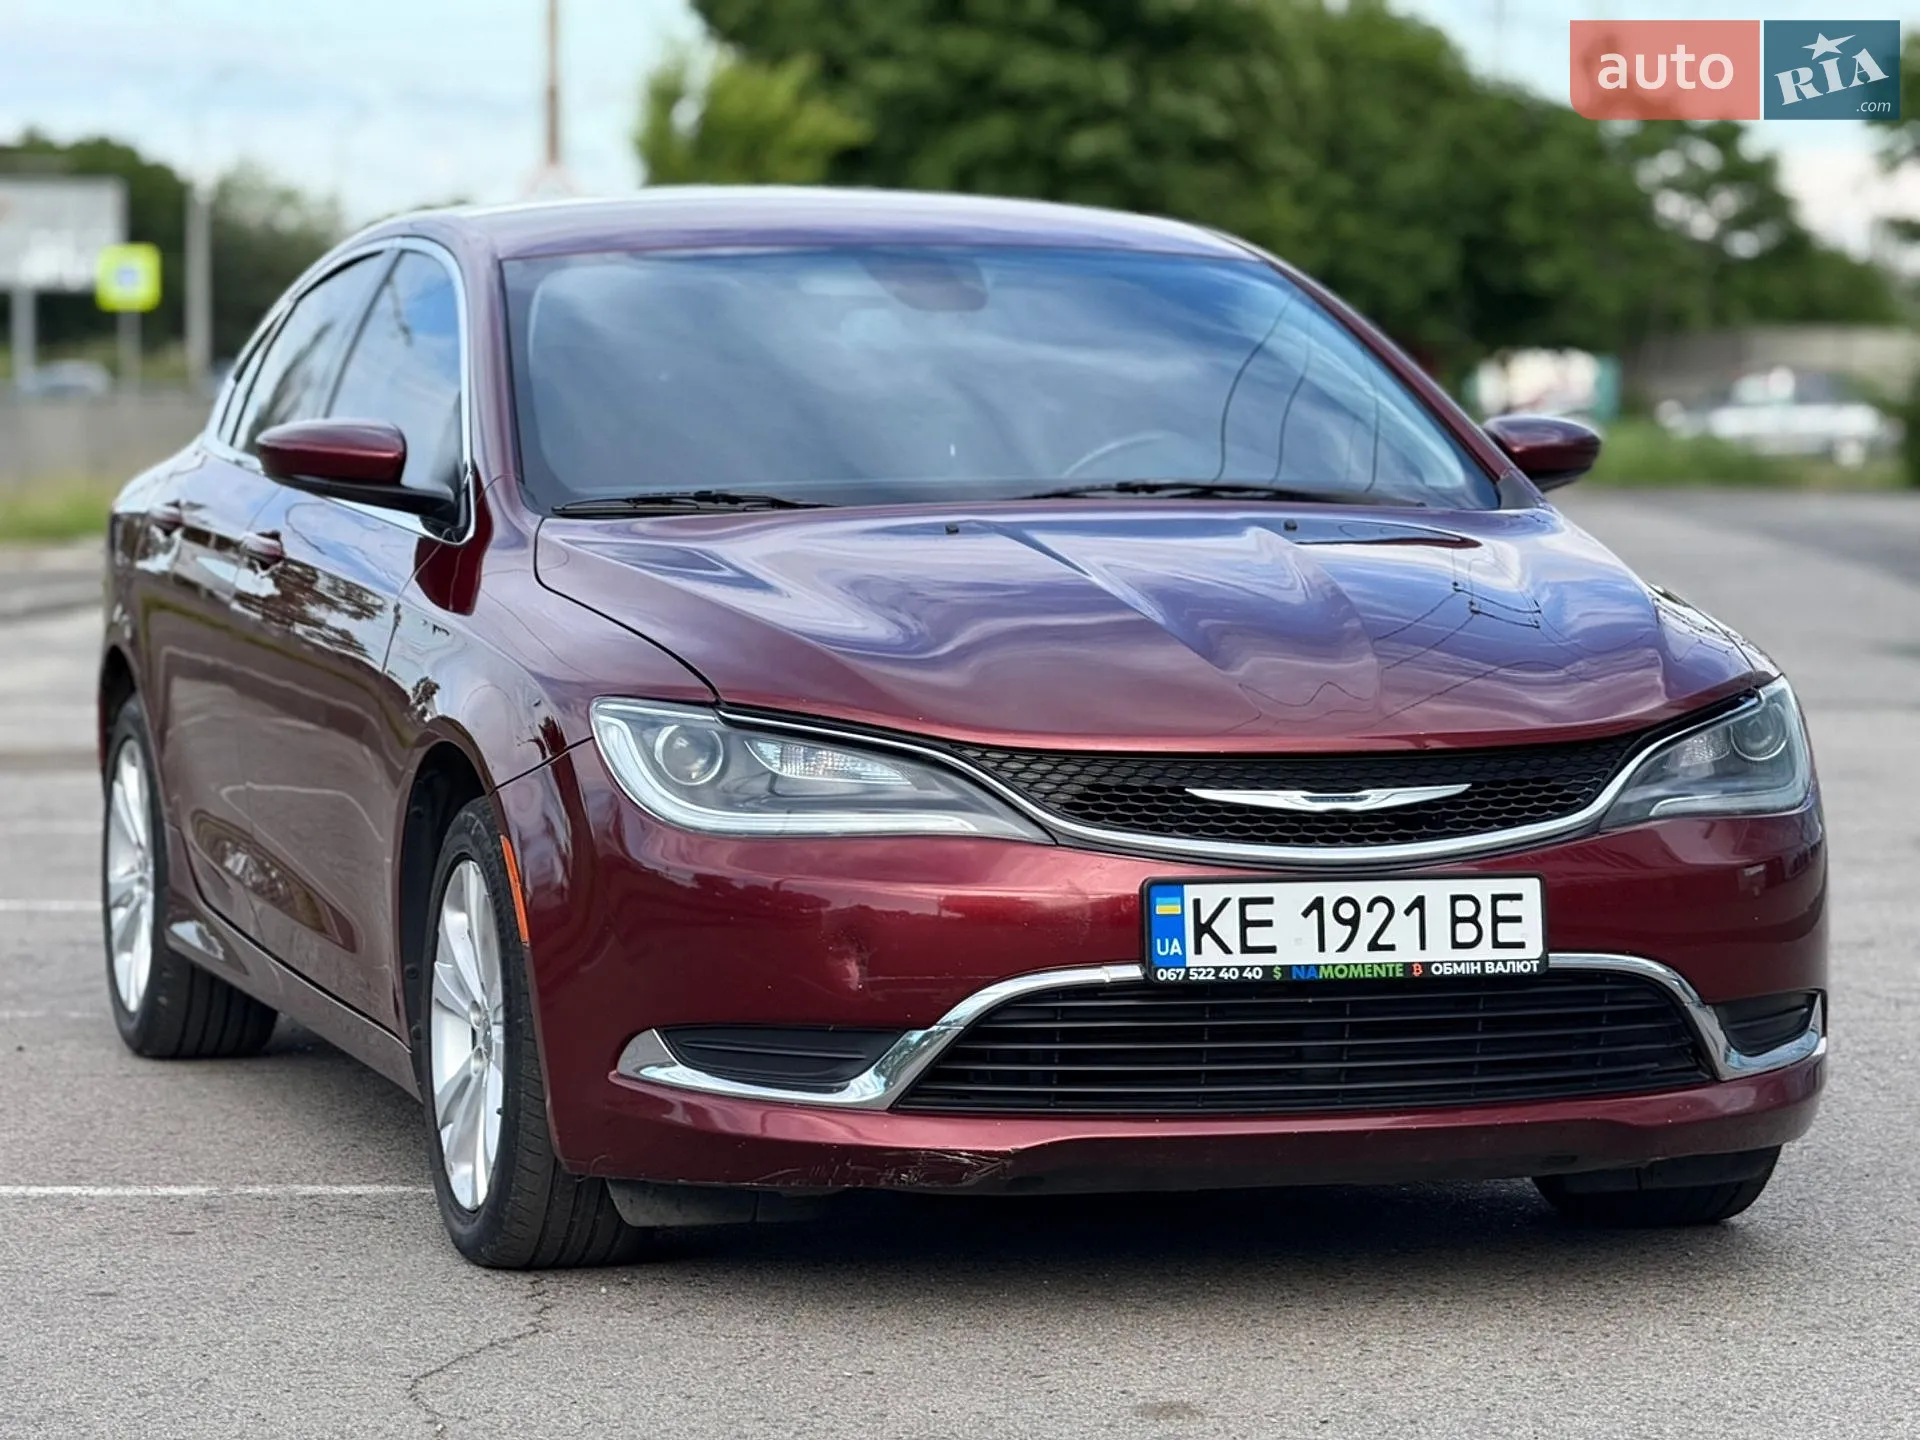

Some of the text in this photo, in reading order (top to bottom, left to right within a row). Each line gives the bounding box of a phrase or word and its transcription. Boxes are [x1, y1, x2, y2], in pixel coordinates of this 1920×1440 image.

[1192, 893, 1526, 955] KE 1921 BE
[1156, 938, 1183, 957] UA
[1157, 967, 1186, 981] 067
[1189, 967, 1216, 980] 522
[1219, 967, 1239, 980] 40
[1243, 966, 1263, 980] 40
[1431, 960, 1540, 976] ОБМІН ВАЛЮТ
